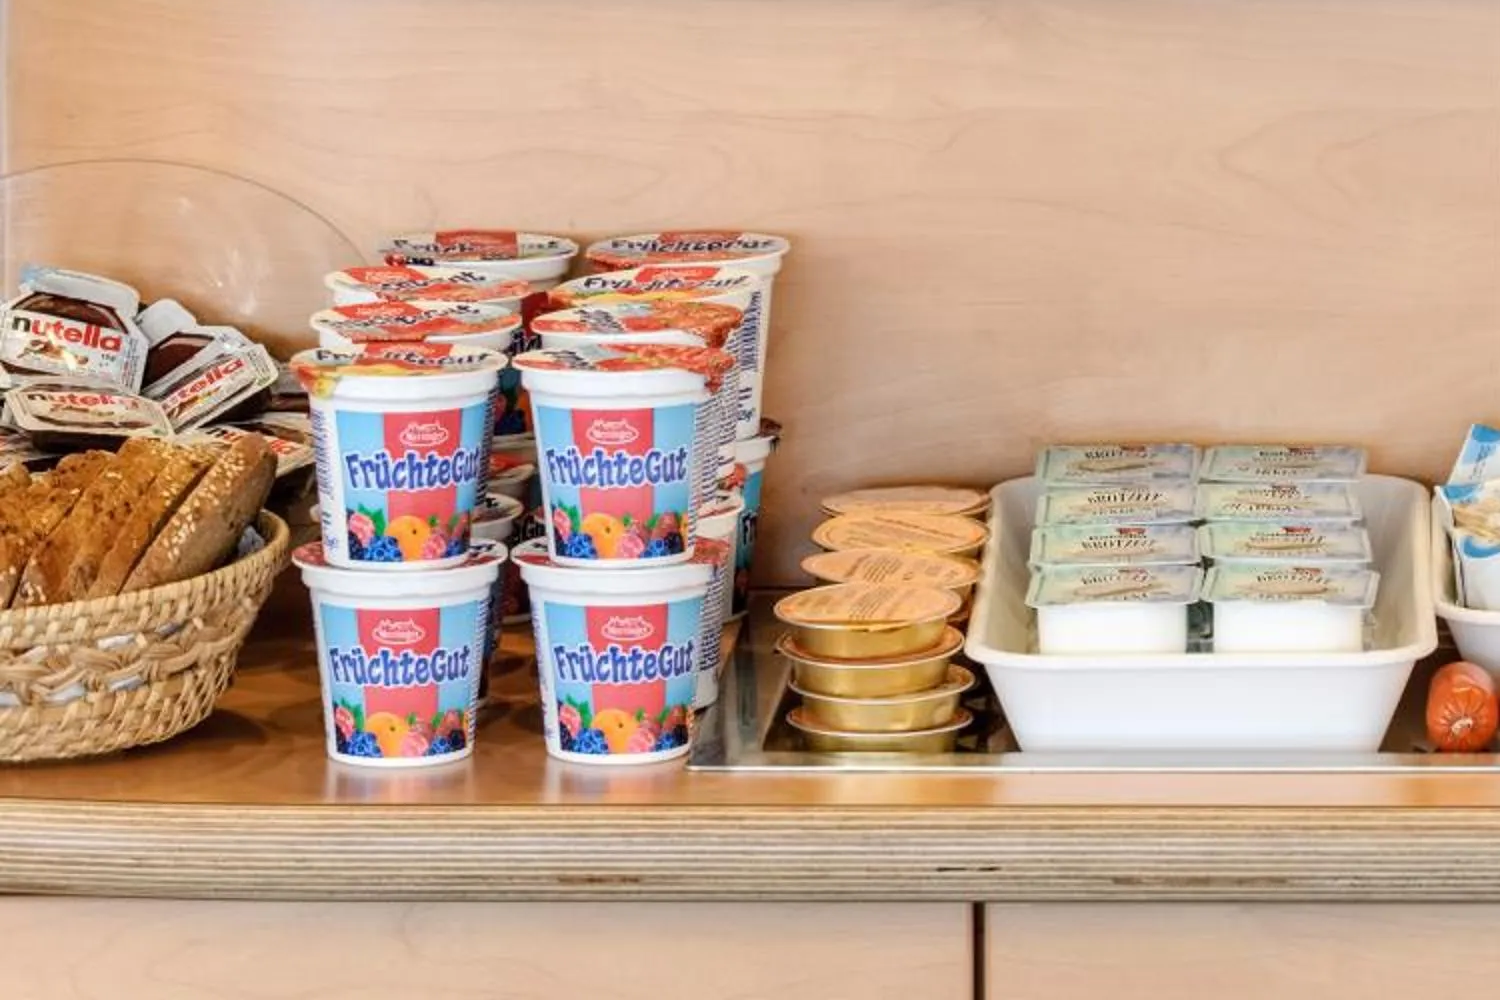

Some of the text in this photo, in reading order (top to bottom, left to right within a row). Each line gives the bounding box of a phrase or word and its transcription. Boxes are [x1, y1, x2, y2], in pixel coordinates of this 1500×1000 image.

[12, 316, 122, 352] nutella
[546, 447, 688, 487] FrüchteGut
[329, 646, 471, 687] FrüchteGut
[553, 641, 694, 684] FrüchteGut
